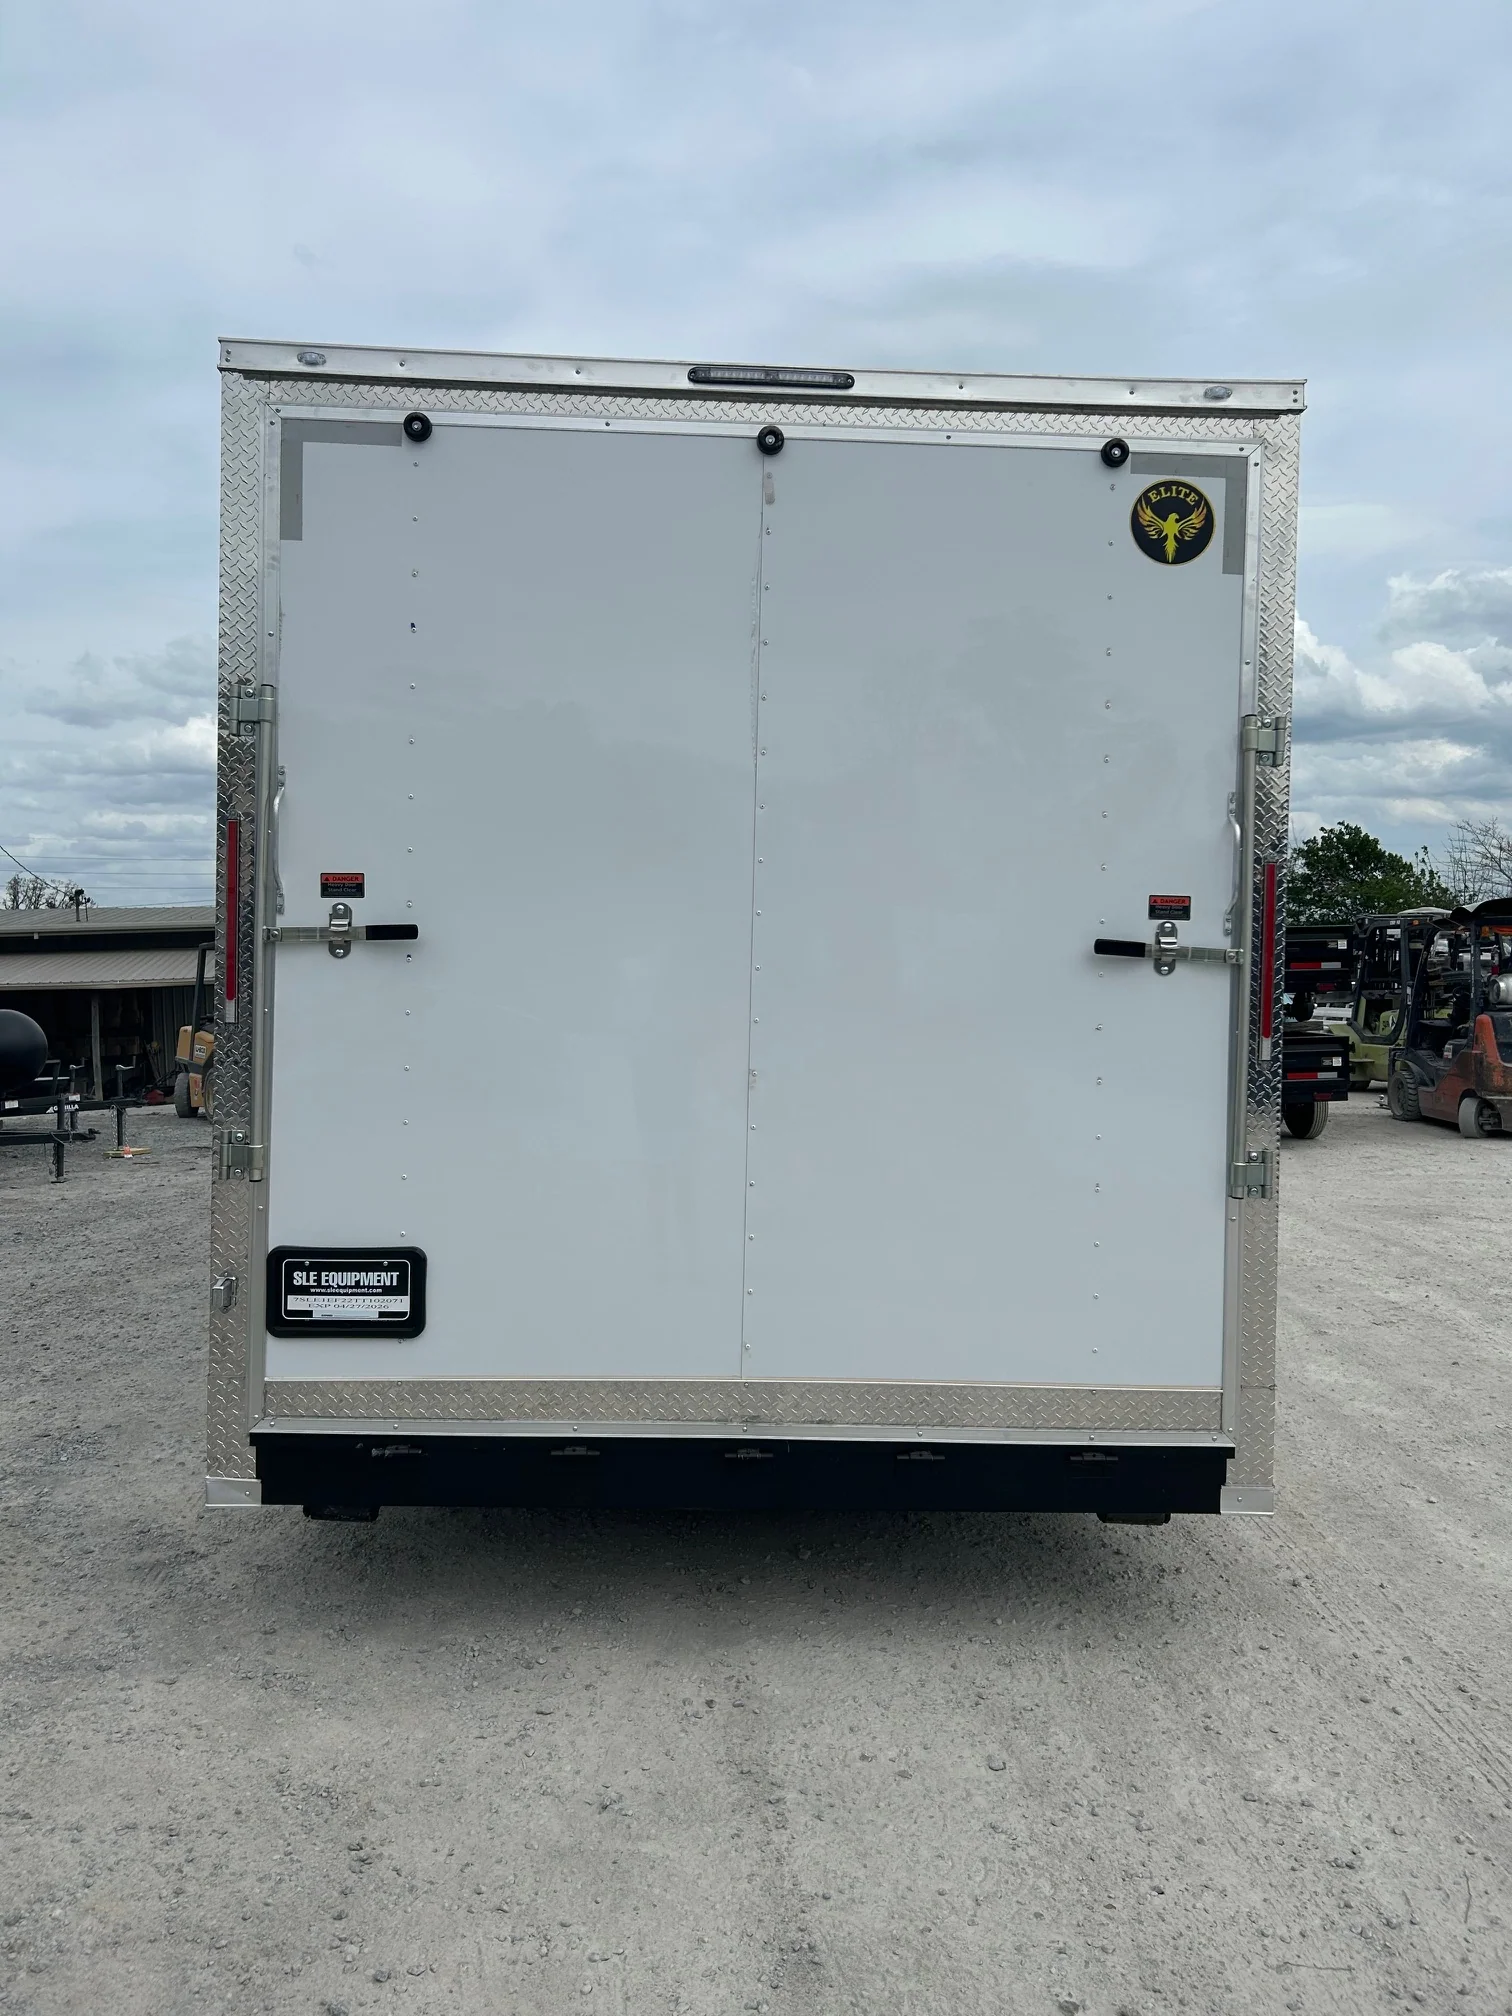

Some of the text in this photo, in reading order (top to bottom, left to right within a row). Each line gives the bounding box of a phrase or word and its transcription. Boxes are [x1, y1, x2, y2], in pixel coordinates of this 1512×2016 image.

[1147, 485, 1199, 506] ELITE
[293, 1271, 400, 1288] SLE EQUIPMENT
